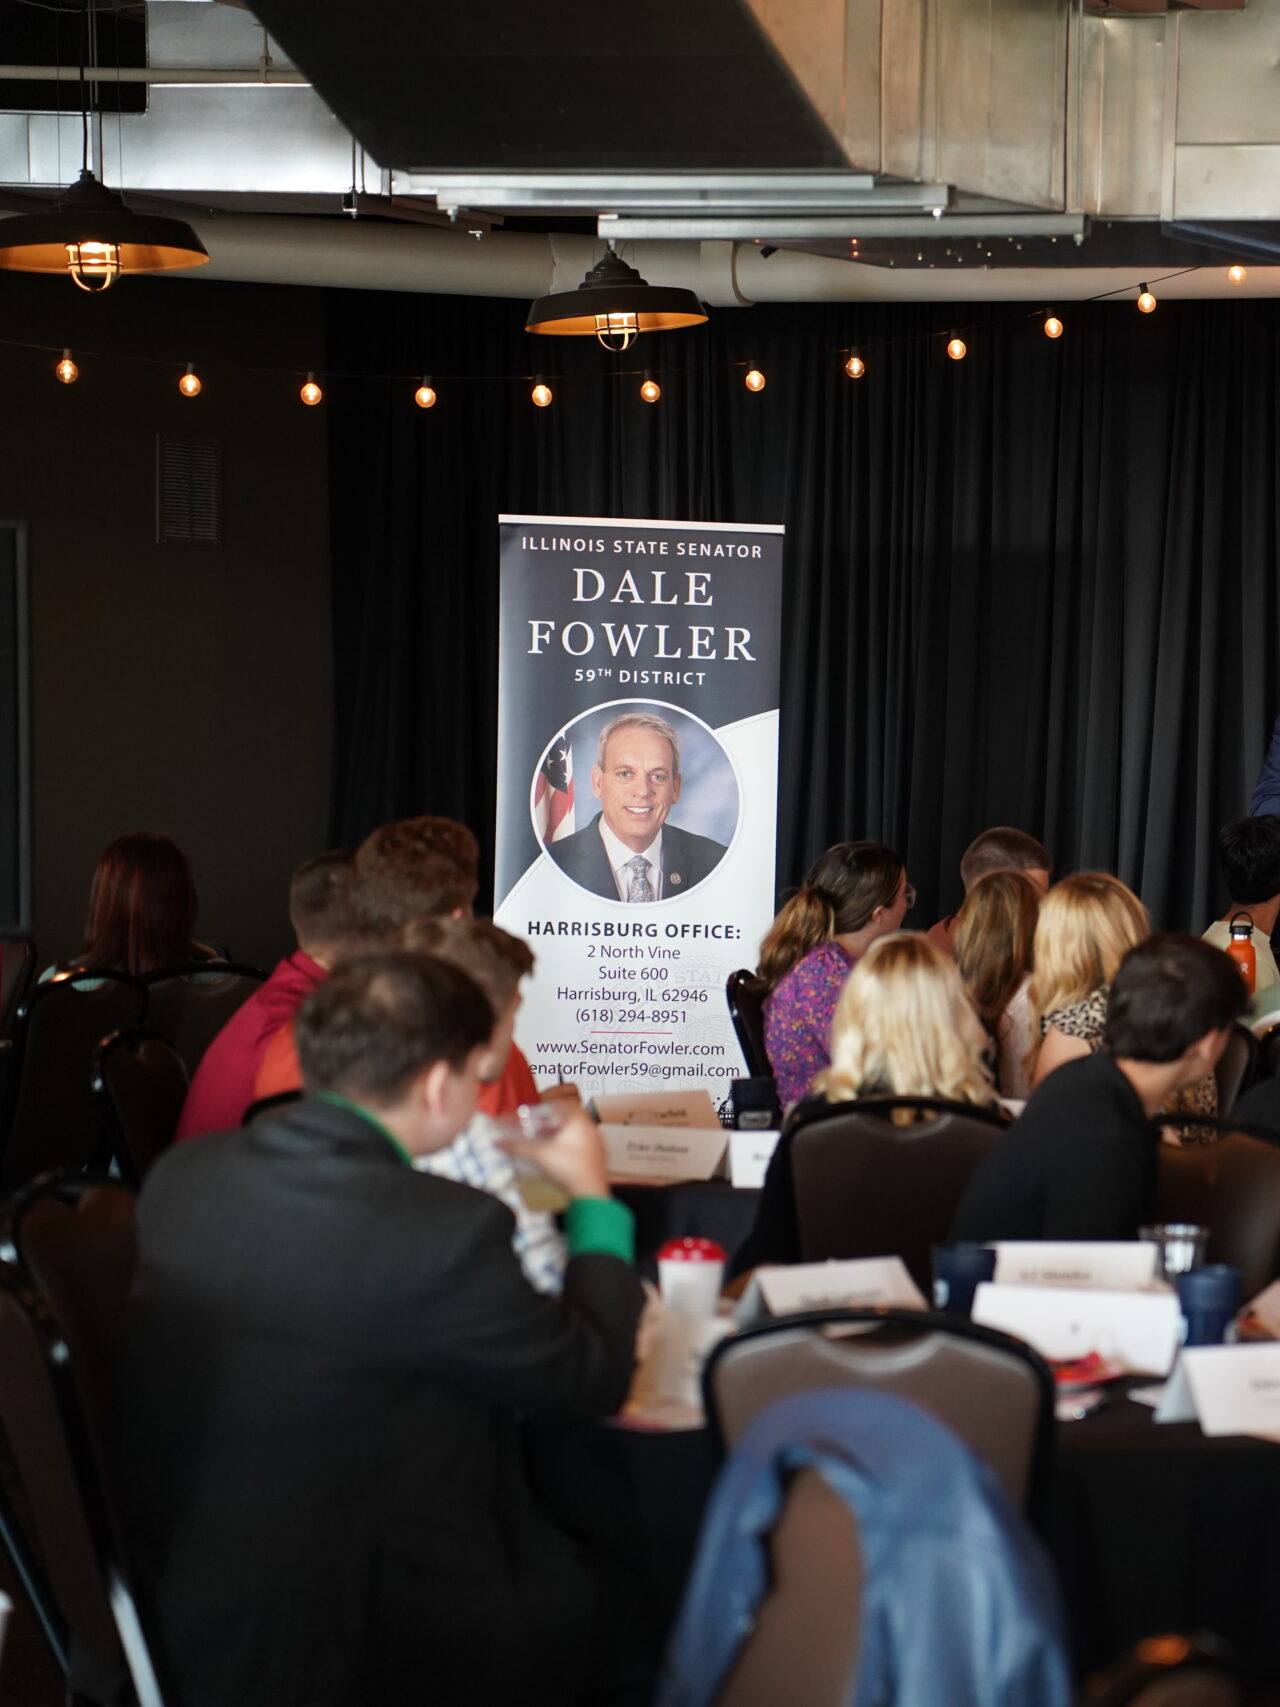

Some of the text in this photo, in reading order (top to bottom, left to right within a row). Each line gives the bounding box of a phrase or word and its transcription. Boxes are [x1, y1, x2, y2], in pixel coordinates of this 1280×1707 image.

[521, 536, 763, 559] ILLINOIS STATE SENATOR
[572, 567, 714, 607] DALE
[527, 620, 757, 661] FOWLER
[574, 668, 706, 686] 59TH DISTRICT
[527, 921, 742, 940] HARRISBURG OFFICE:
[587, 945, 682, 960] 2 North Vine
[598, 966, 669, 981] Suite 600
[557, 986, 709, 1005] Harrisburg, IL 62946
[575, 1008, 688, 1024] (618) 294-8951
[536, 1040, 726, 1056] www.SenatorFowler.com
[529, 1061, 741, 1080] enatorFowler59@gmail.com
